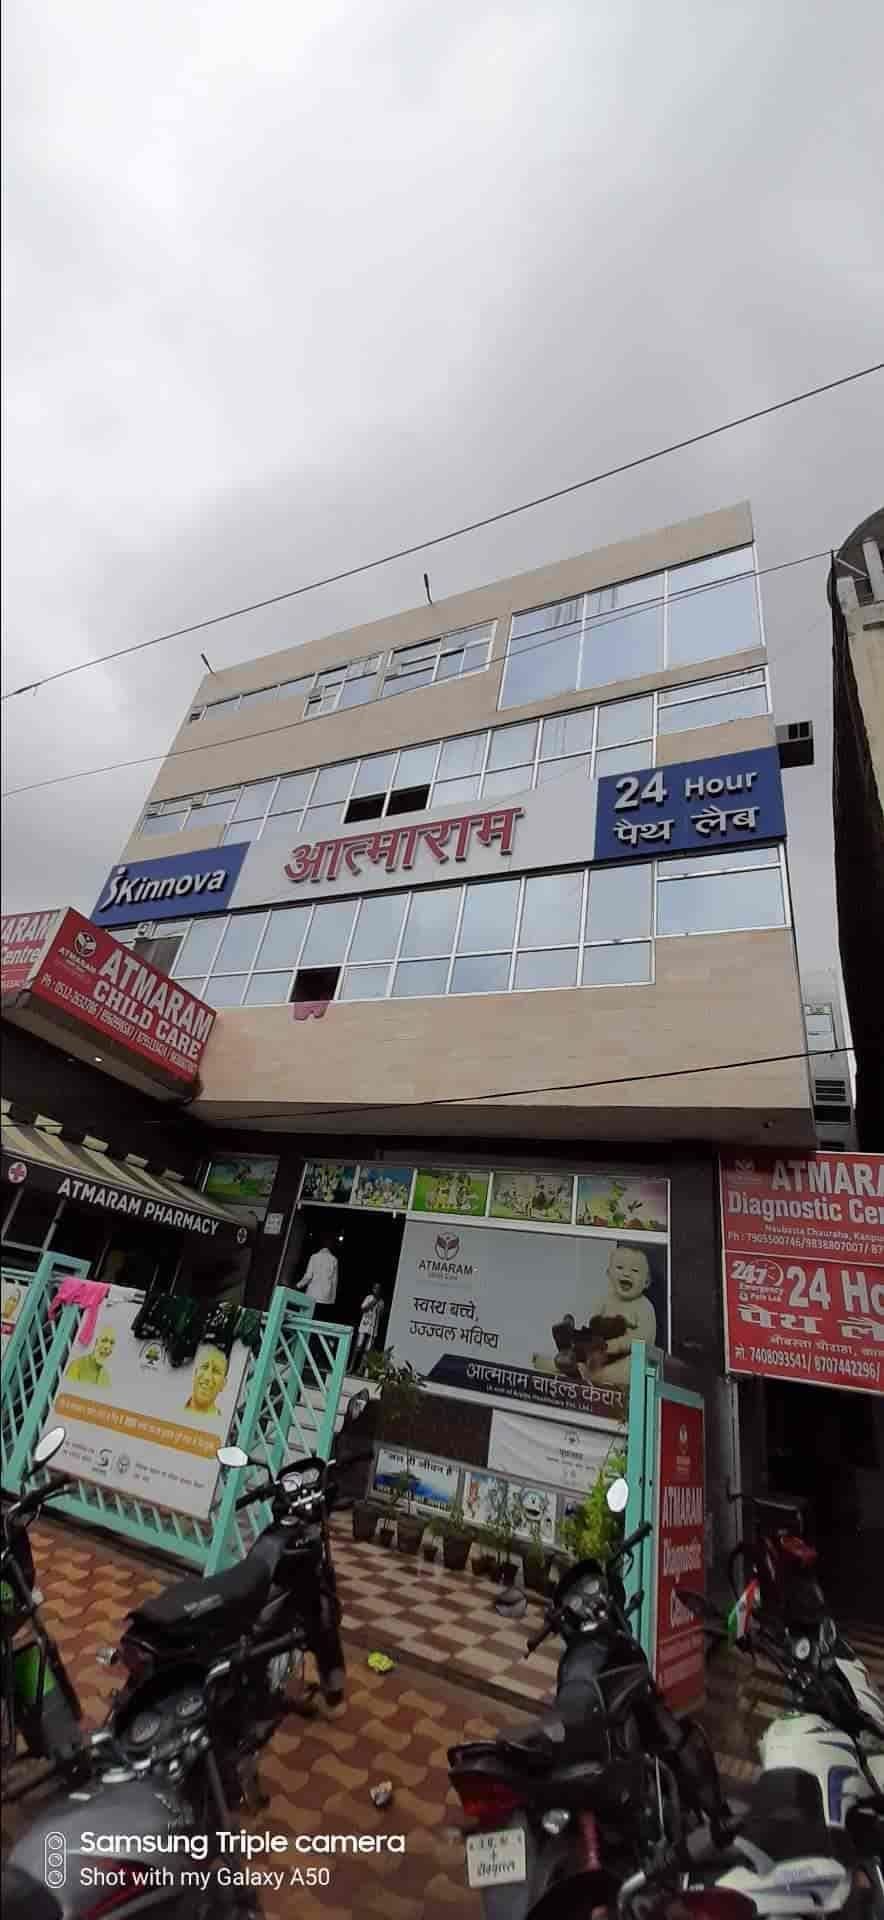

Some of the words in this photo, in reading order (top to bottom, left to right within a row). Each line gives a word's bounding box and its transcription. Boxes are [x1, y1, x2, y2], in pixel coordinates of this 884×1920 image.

[614, 770, 667, 809] 24
[685, 772, 758, 798] Hour
[285, 806, 523, 882] आत्माराम
[613, 818, 674, 845] पैथ
[690, 803, 760, 834] लैब
[99, 949, 213, 1043] ATMARAM
[93, 980, 153, 1030] CHILD
[155, 1020, 201, 1058] CARE
[57, 1177, 141, 1216] ATMARAM
[144, 1202, 219, 1236] PHARMACY
[728, 1191, 842, 1222] Diagnostic
[418, 1259, 473, 1275] ATMARAM
[786, 1265, 831, 1311] 24
[466, 1362, 528, 1389] आत्माराम
[662, 1485, 704, 1529] ATMARAM
